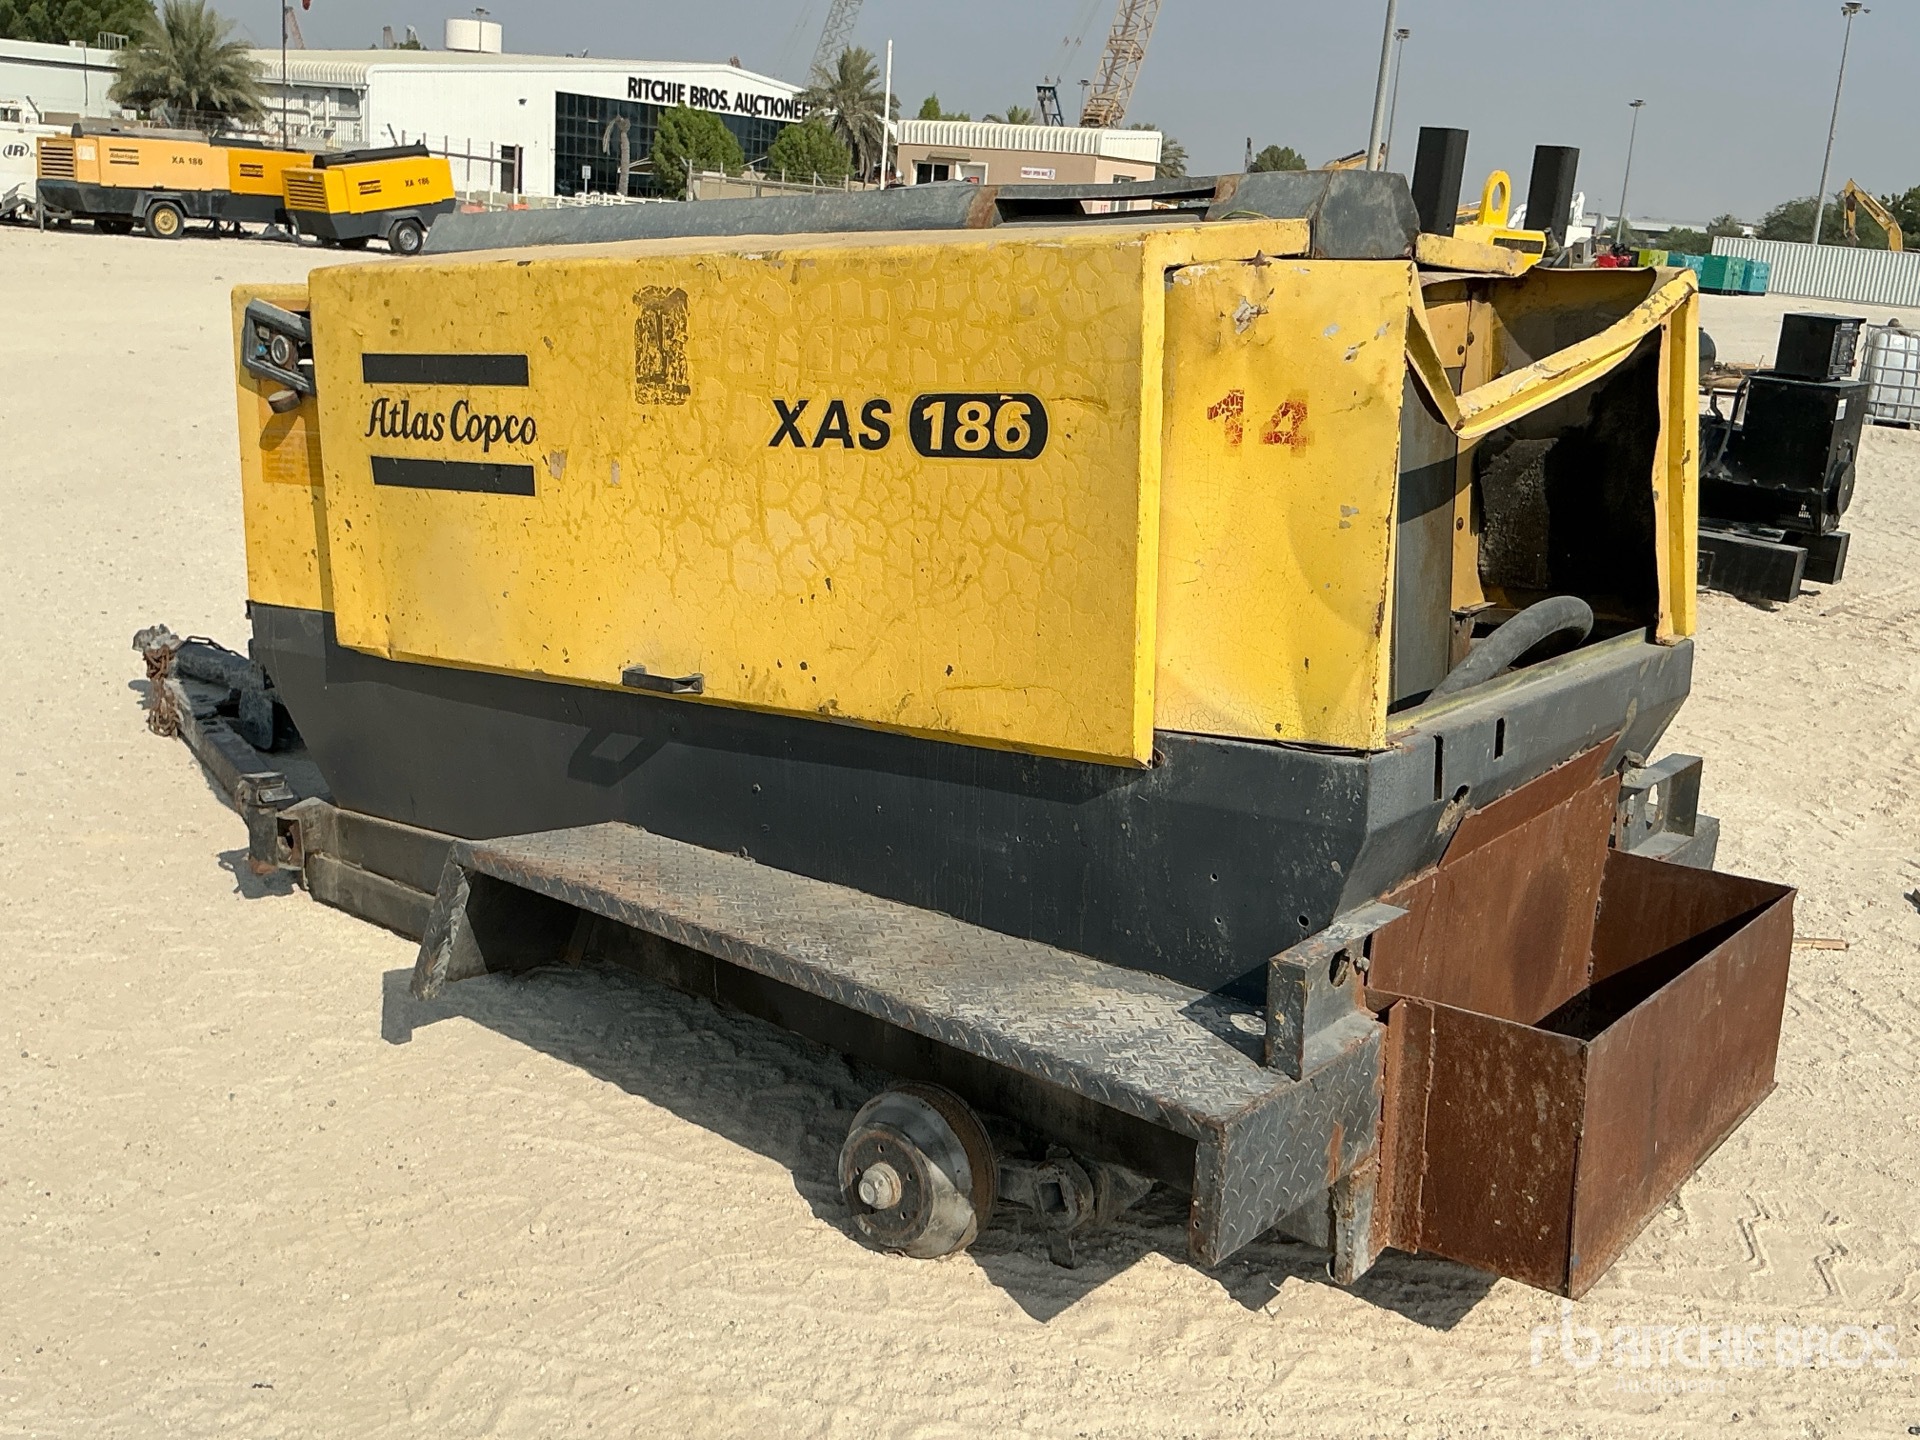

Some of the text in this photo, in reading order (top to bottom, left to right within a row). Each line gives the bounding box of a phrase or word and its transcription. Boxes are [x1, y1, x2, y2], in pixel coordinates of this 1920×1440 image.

[627, 76, 814, 119] RITCHIE BROS. AUCTIONEE
[171, 155, 185, 165] XA
[365, 397, 537, 453] Atlas Copco
[768, 399, 1032, 455] XAS 186
